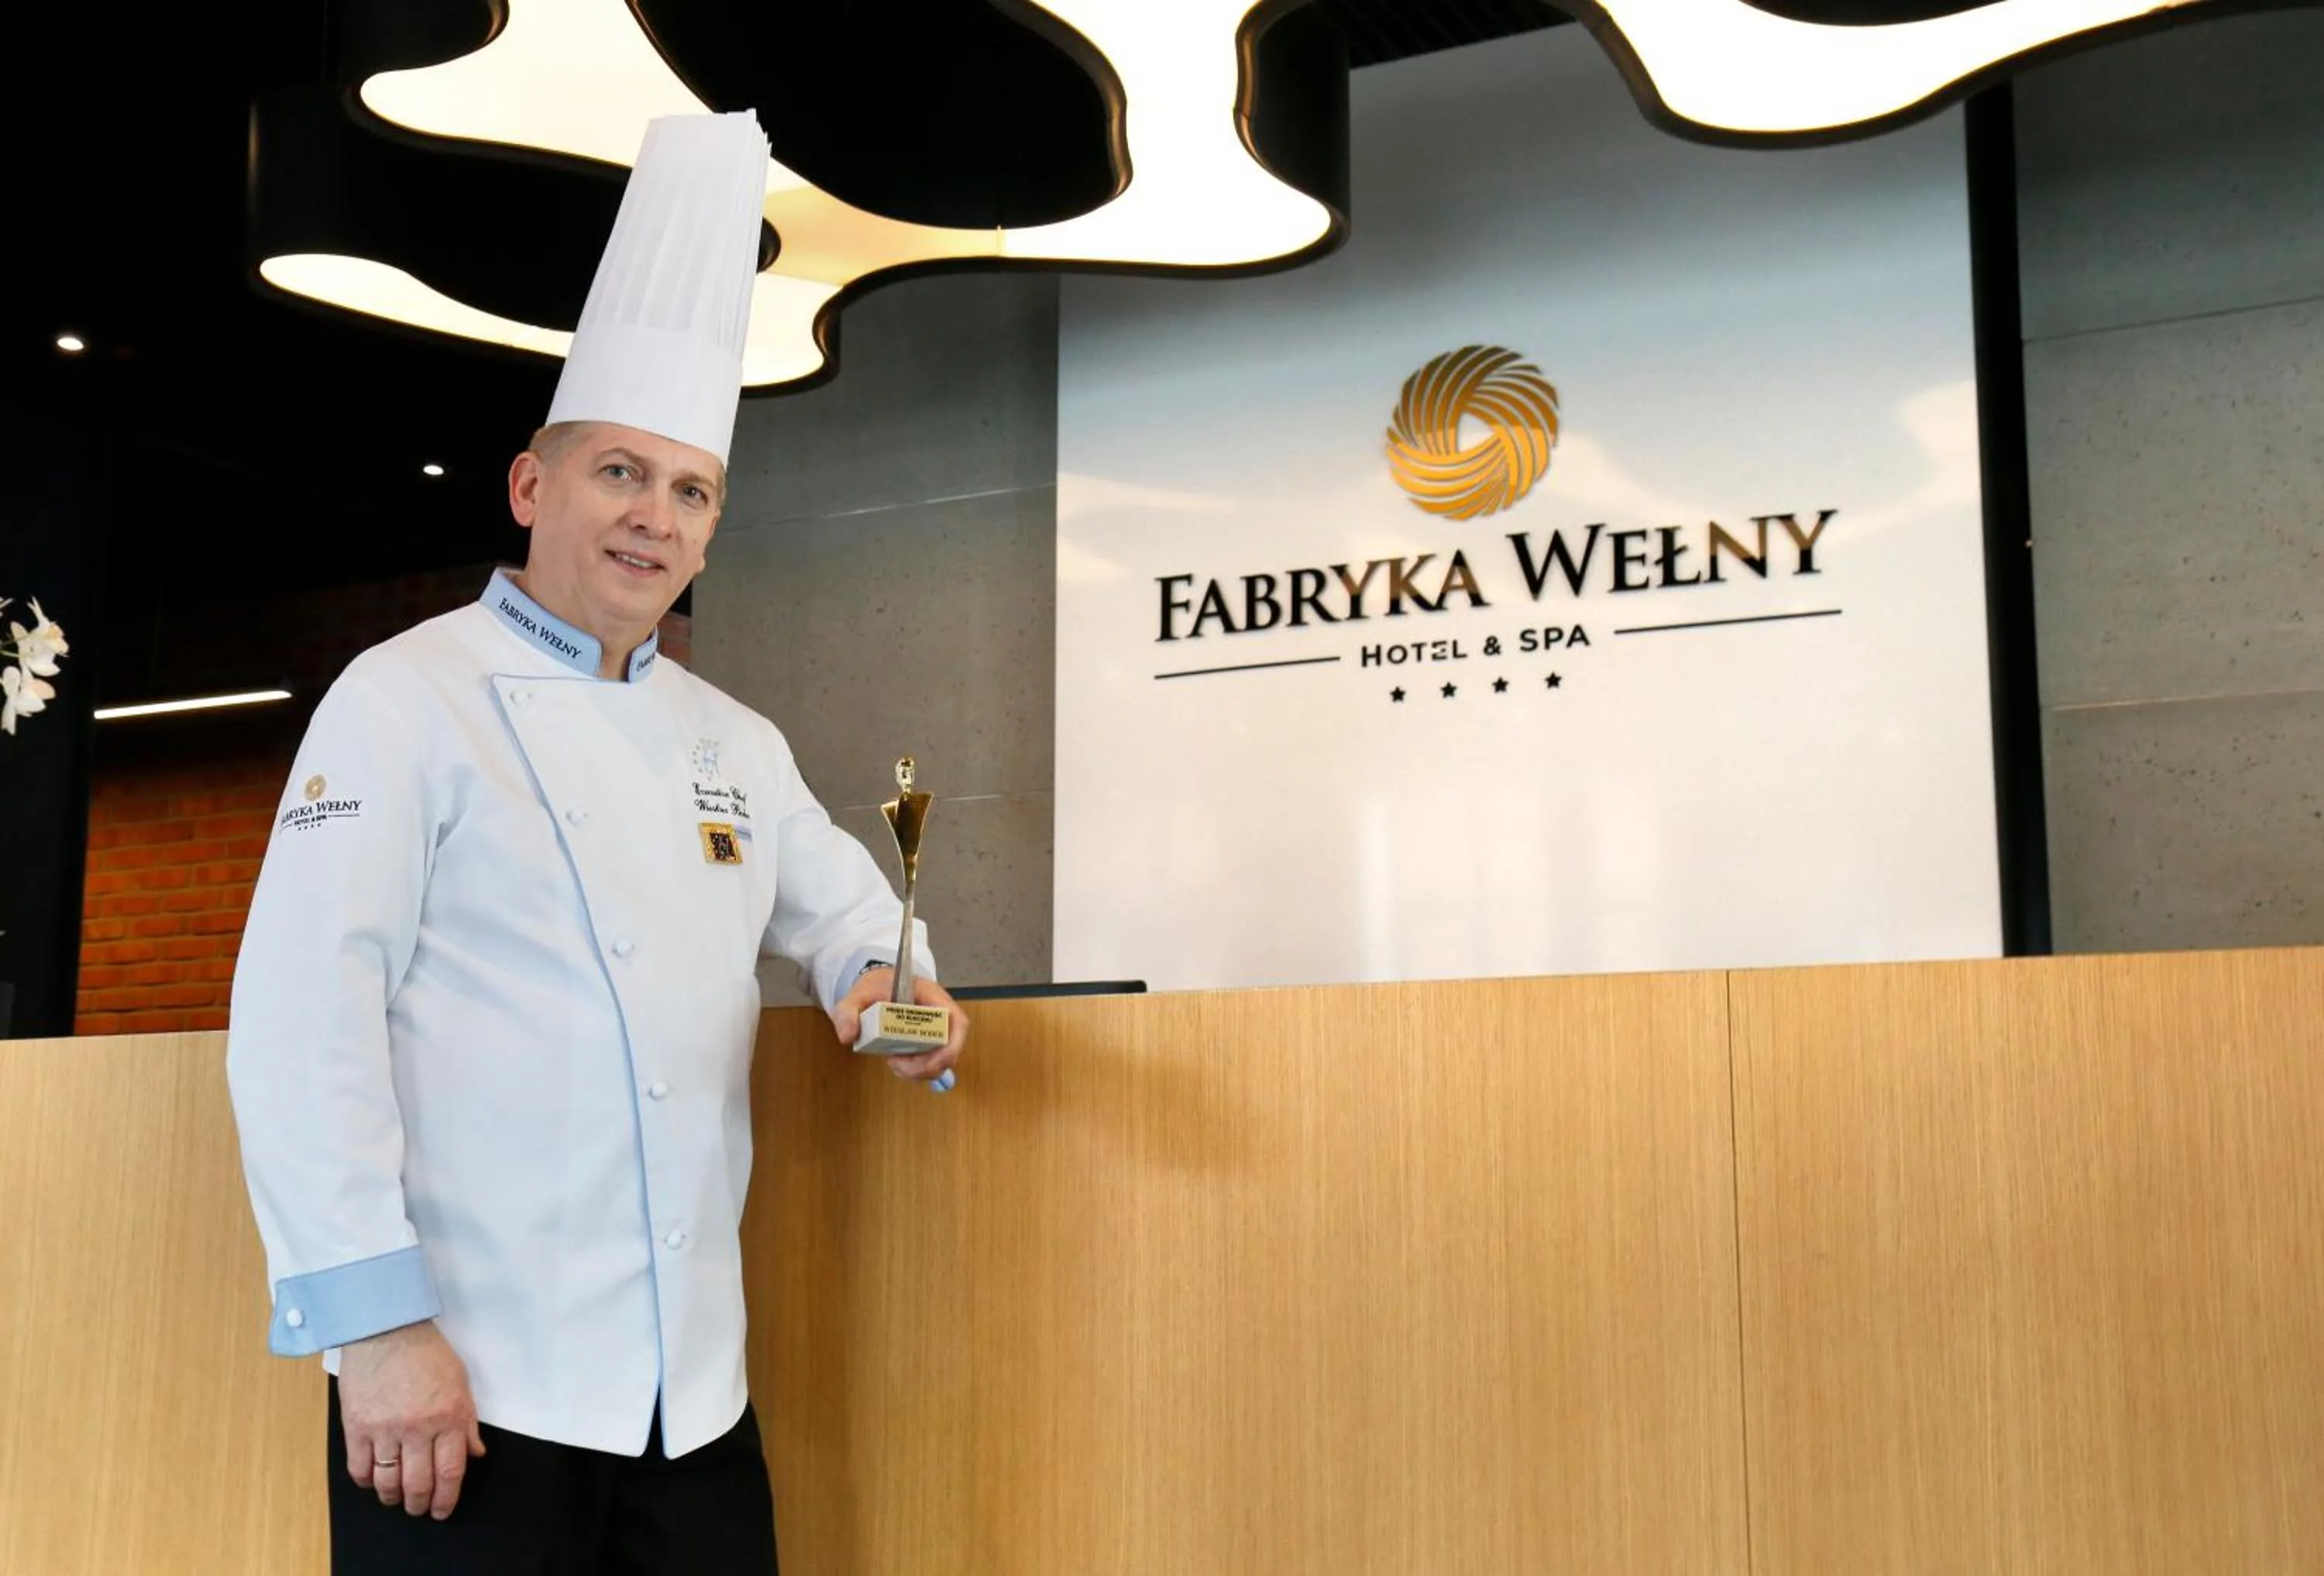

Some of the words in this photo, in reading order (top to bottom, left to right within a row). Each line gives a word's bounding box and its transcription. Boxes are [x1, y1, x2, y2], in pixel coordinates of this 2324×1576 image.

[1154, 548, 1492, 642] FABRYKA
[1505, 509, 1838, 602] WEŁNY
[499, 597, 537, 634] FABRYKA
[539, 625, 582, 659] WEŁNY
[1361, 639, 1468, 668] HOTEL
[1483, 635, 1503, 657] &
[1519, 623, 1591, 652] SPA
